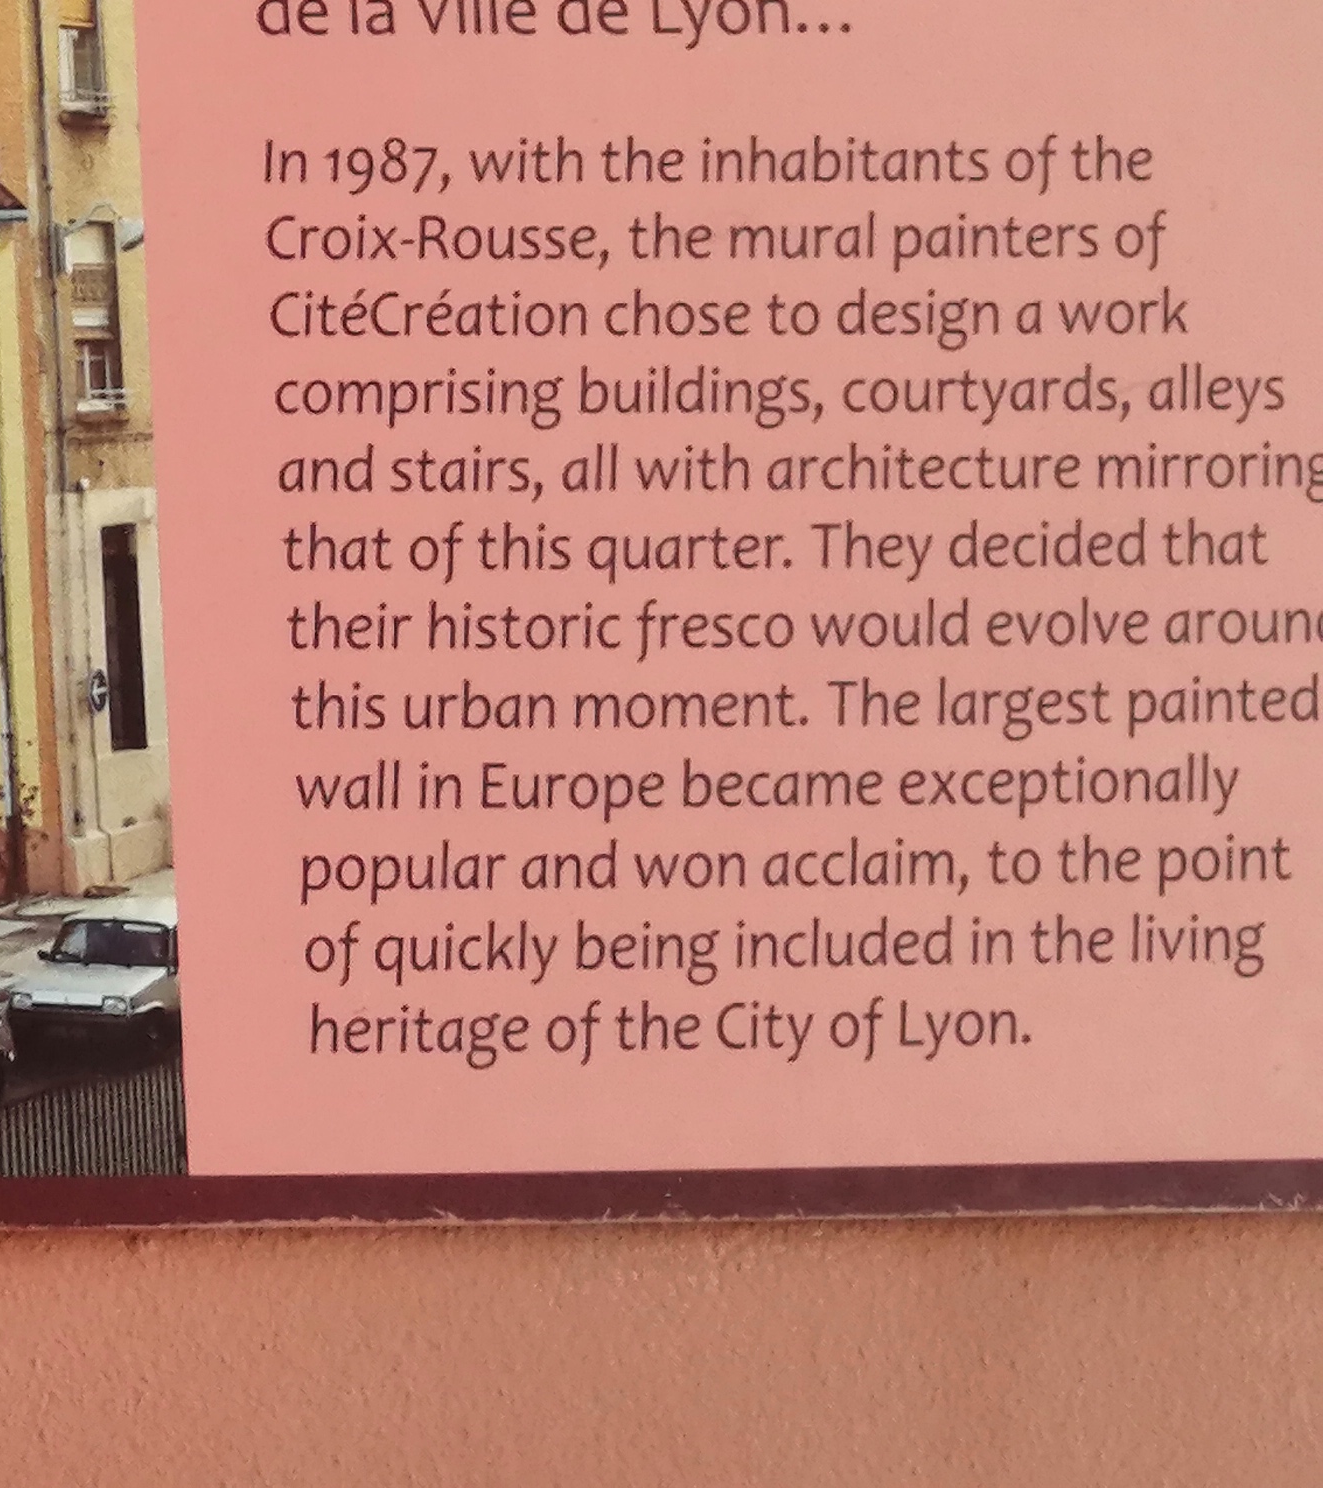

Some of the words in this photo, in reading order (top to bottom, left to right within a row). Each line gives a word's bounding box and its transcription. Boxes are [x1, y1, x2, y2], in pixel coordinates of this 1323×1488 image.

[264, 139, 307, 183] In
[324, 137, 451, 196] 1987,
[469, 135, 583, 183] with
[601, 135, 684, 183] the
[702, 135, 989, 182] inhabitants
[1005, 133, 1057, 195] of
[1071, 134, 1153, 182] the
[266, 214, 609, 270] Croix-Rousse,
[628, 211, 713, 259] the
[730, 211, 875, 259] mural
[893, 213, 1098, 273] painters
[1115, 209, 1167, 271] of
[275, 367, 564, 431] comprising
[579, 365, 824, 430] buildings,
[843, 363, 1130, 426] courtyards,
[1148, 362, 1285, 424] alleys
[278, 443, 374, 493] and
[390, 445, 543, 503] stairs,
[562, 443, 618, 492] all
[635, 442, 750, 491] with
[767, 442, 1080, 491] architecture
[1098, 441, 1323, 504] mirroring
[287, 600, 412, 650] their
[428, 599, 621, 650] historic
[636, 599, 794, 663] fresco
[810, 597, 969, 648] would
[986, 596, 1149, 647] evolve
[1165, 608, 1323, 645] aroun
[291, 679, 386, 730] this
[404, 679, 555, 730] urban
[574, 684, 808, 729] moment.
[827, 677, 920, 727] The
[938, 676, 1111, 741] largest
[1128, 673, 1319, 738] painted
[296, 759, 400, 810] wall
[419, 761, 461, 809] in
[481, 762, 665, 824] Europe
[683, 758, 883, 808] became
[899, 752, 1239, 819] exceptionally
[301, 839, 506, 906] popular
[521, 838, 617, 890] and
[634, 852, 745, 889] won
[763, 836, 969, 896] acclaim,
[987, 841, 1041, 885] to
[1058, 834, 1141, 884] the
[1158, 833, 1291, 897] point
[305, 920, 361, 986] of
[375, 920, 558, 986] quickly
[576, 919, 720, 986] being
[736, 915, 953, 968] included
[972, 917, 1013, 965] in
[1030, 914, 1114, 964] the
[1131, 913, 1265, 978] living
[311, 1002, 529, 1070] heritage
[546, 999, 601, 1066] of
[615, 1000, 701, 1051] the
[716, 1000, 814, 1063] City
[830, 996, 884, 1061] of
[899, 1000, 1031, 1061] Lyon.
